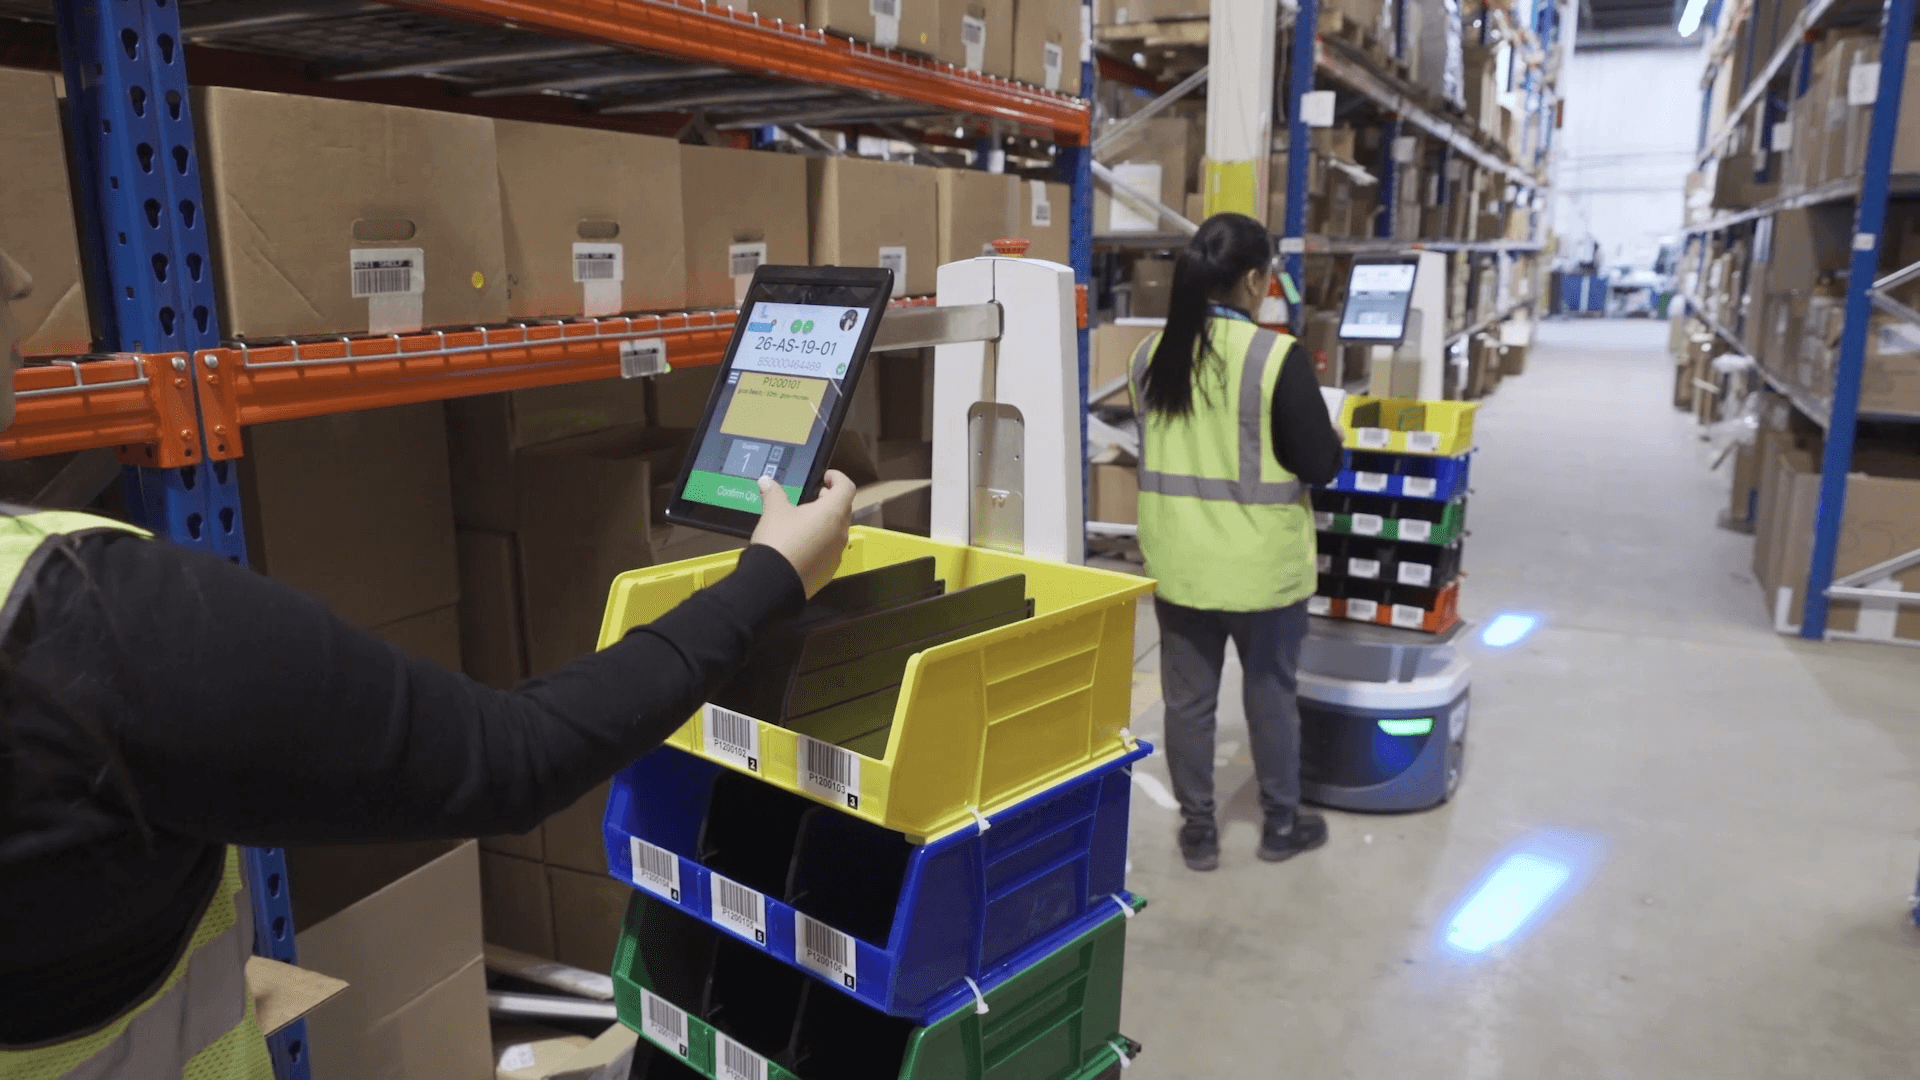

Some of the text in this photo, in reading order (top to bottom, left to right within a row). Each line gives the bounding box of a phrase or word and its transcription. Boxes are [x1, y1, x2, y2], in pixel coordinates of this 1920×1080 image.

[755, 336, 837, 356] 26-AS-19-01
[757, 356, 821, 371] 850000464469
[762, 376, 802, 390] P1200101
[741, 453, 751, 473] 1
[716, 485, 745, 499] Confirm
[713, 738, 747, 758] P1200102
[808, 772, 846, 795] P1200103
[721, 907, 755, 930] P1200105
